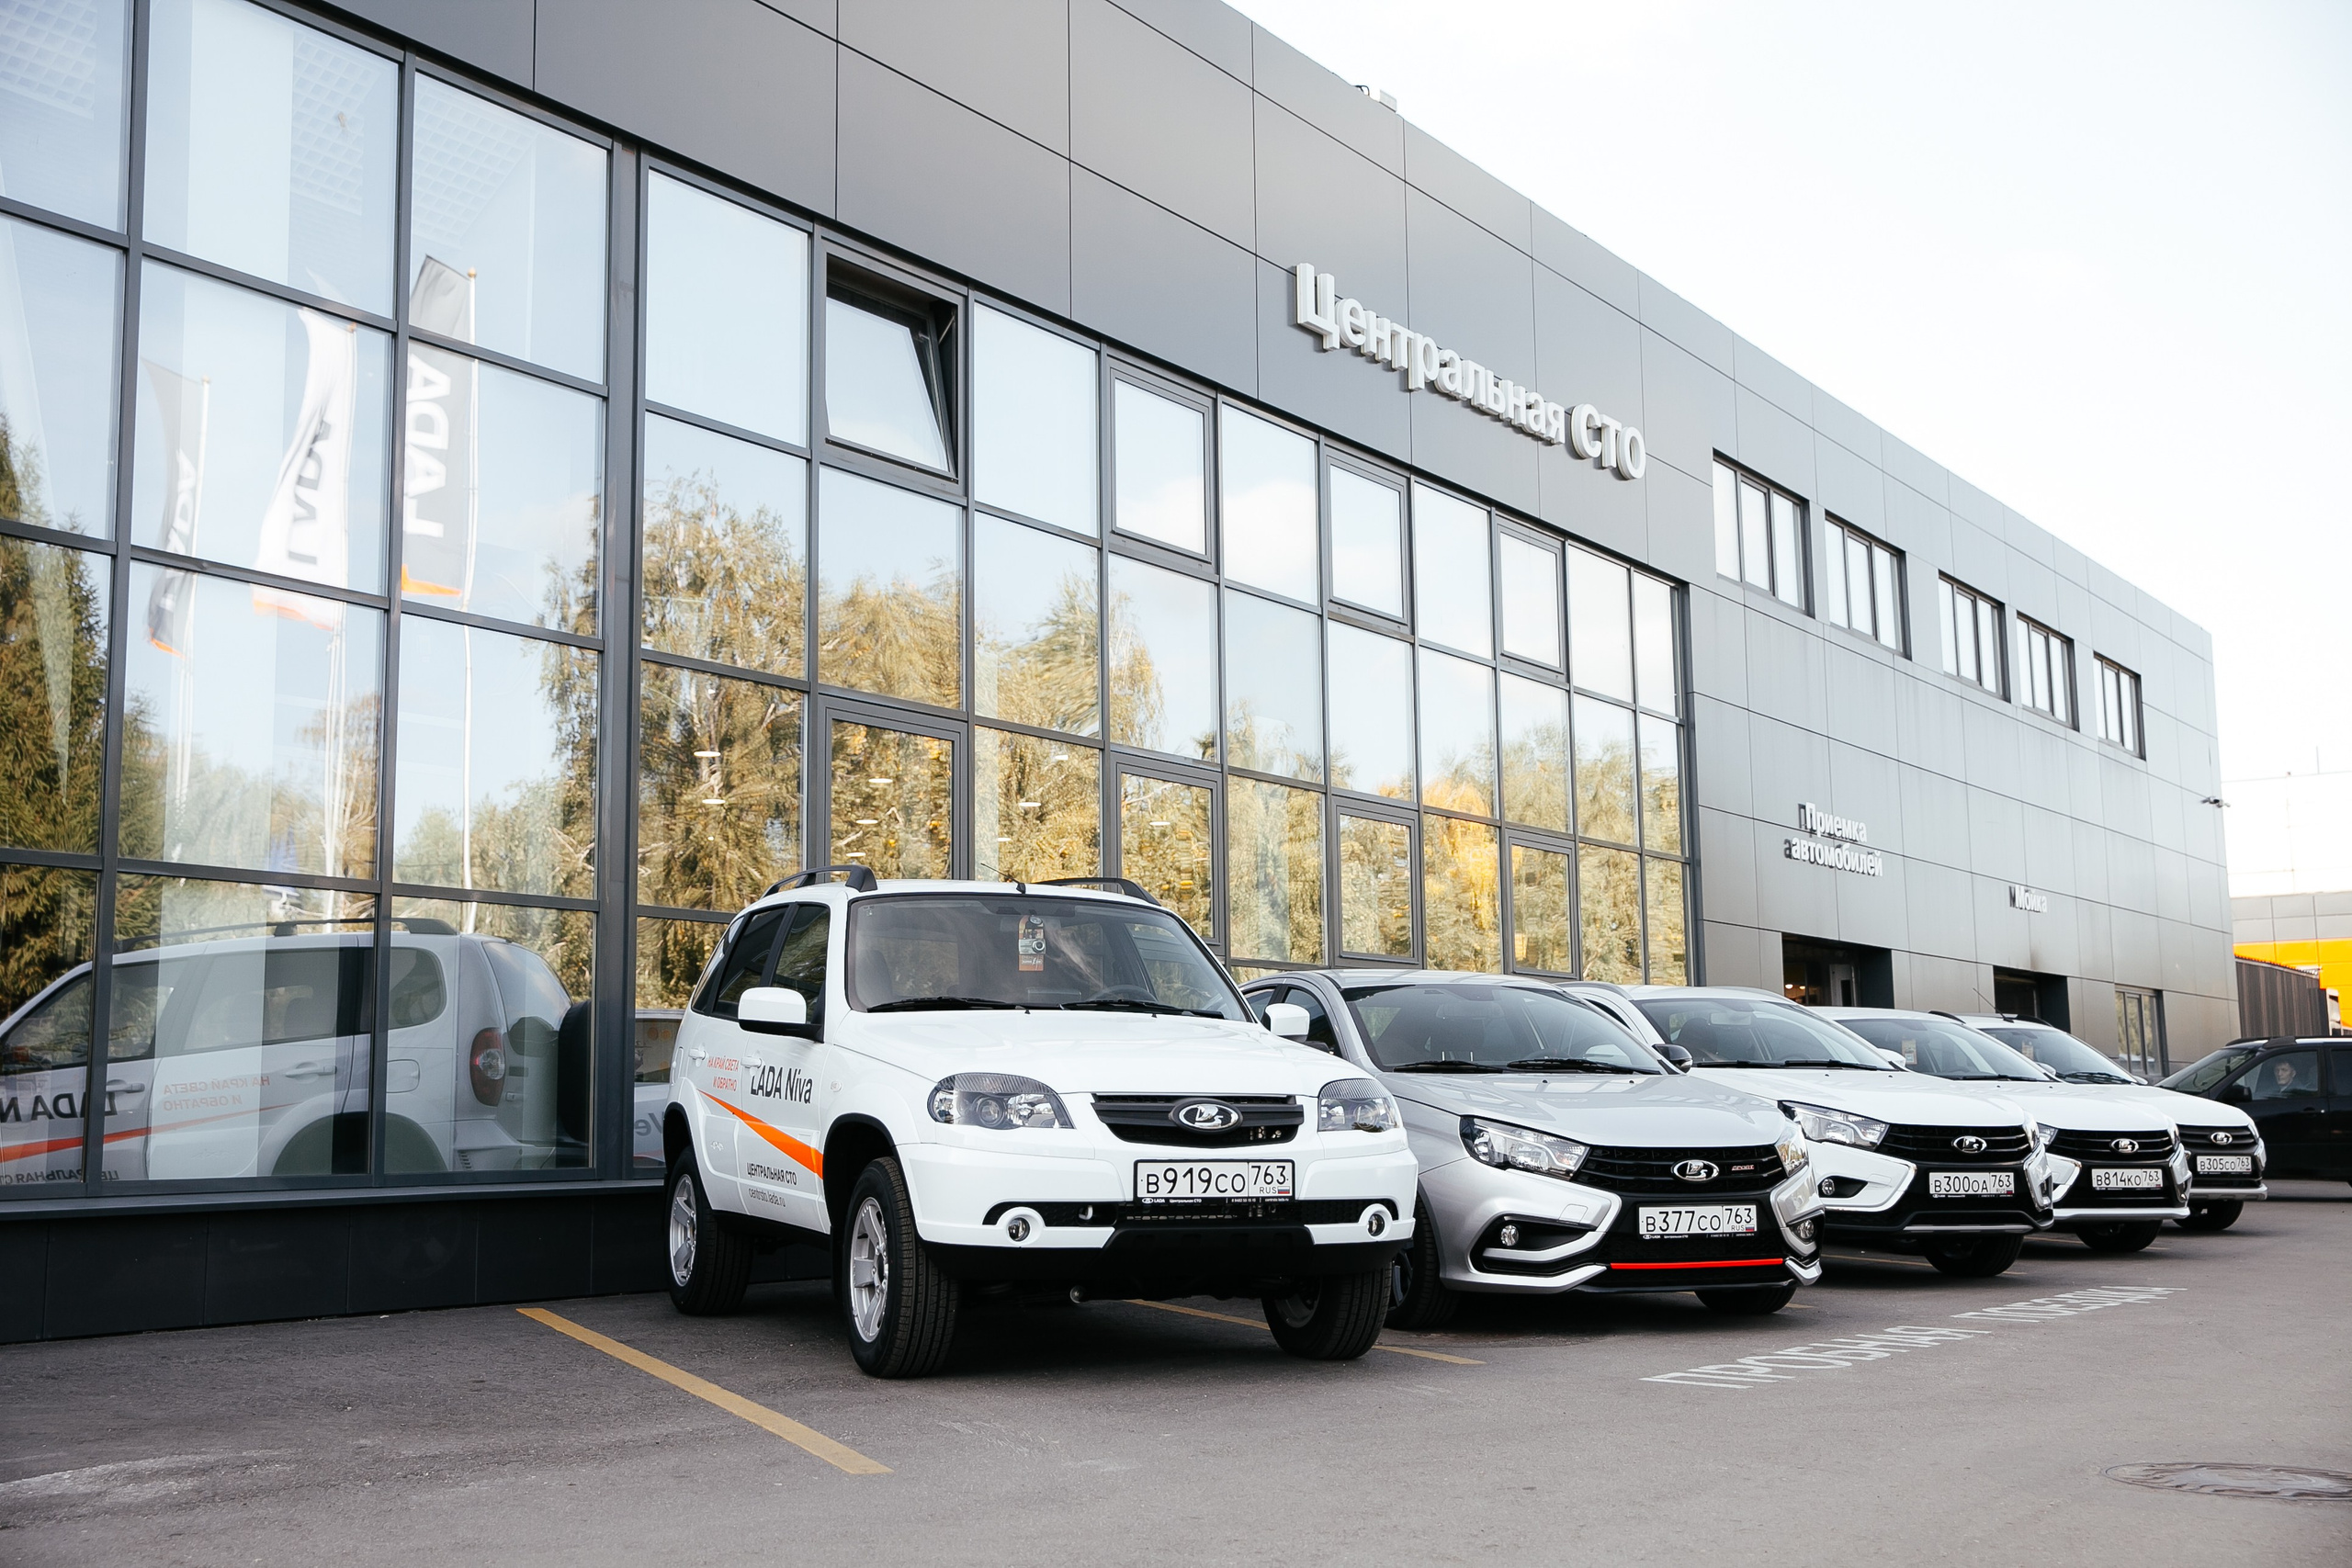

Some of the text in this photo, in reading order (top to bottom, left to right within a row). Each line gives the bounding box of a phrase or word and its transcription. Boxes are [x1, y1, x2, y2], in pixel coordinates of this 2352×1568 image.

[1295, 263, 1647, 480] Центральная СТО
[1805, 802, 1868, 842] Приемка
[1791, 837, 1883, 876] автомобилей
[2015, 885, 2048, 913] Мойка
[714, 1055, 725, 1069] КРАЙ
[725, 1058, 740, 1072] СВЕТА
[718, 1077, 737, 1091] ОБРАТНО
[750, 1065, 813, 1104] LADA Niva
[746, 1162, 797, 1186] ЦЕНТРАЛЬНАЯ СТО
[1250, 1165, 1286, 1186] 763
[1991, 1174, 2011, 1188] 763
[2143, 1170, 2160, 1182] 763
[1724, 1207, 1753, 1224] 763
[1950, 1285, 2188, 1323] ПОЕЗДКА
[1638, 1325, 1993, 1390] ПРОБНАЯ
